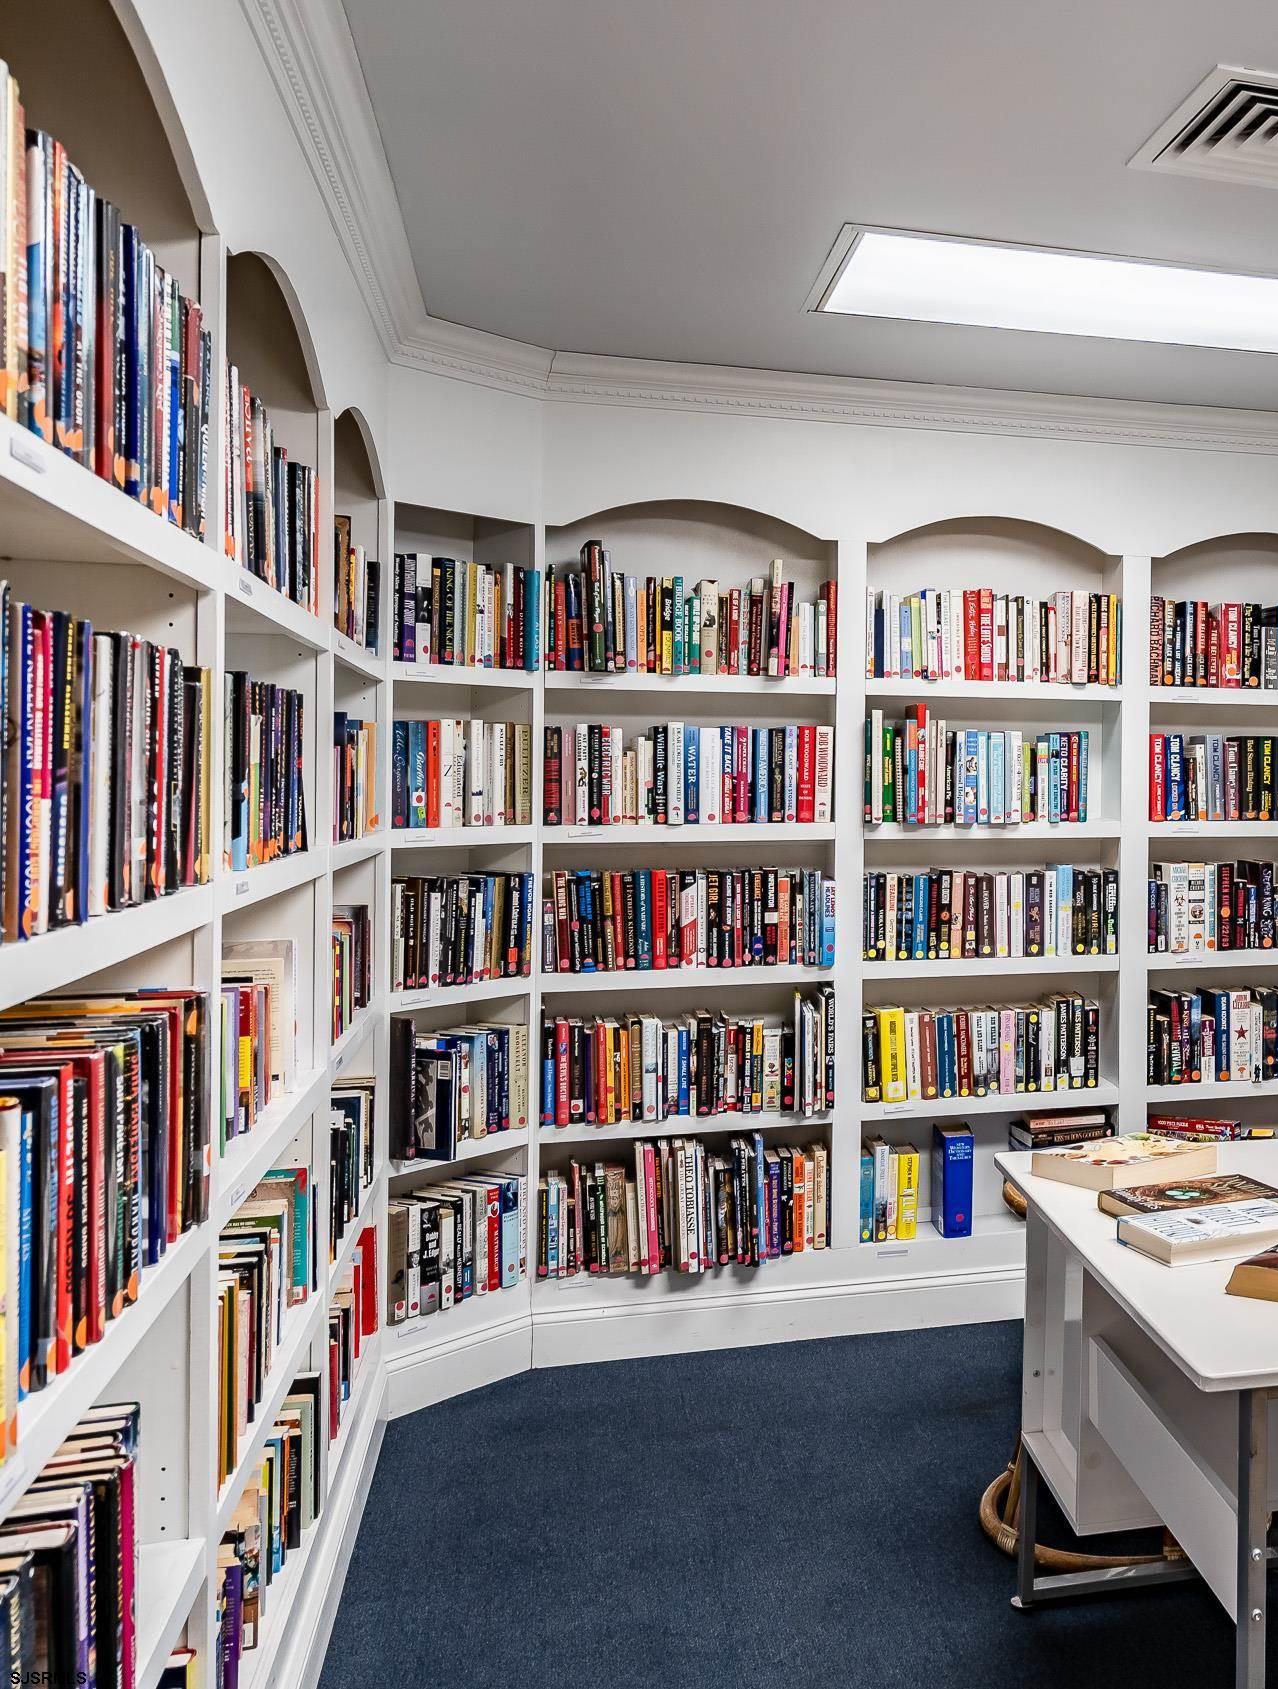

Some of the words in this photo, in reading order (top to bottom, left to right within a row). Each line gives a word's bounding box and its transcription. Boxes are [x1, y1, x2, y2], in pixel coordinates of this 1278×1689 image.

[446, 568, 455, 594] KING
[446, 597, 454, 608] OF
[664, 599, 672, 622] Bridge
[1228, 607, 1237, 621] TOM
[982, 613, 991, 625] THE
[1150, 596, 1159, 637] RICHARD
[982, 626, 991, 641] LATE
[1228, 623, 1237, 648] CLANCY
[981, 643, 991, 663] SHOW
[1150, 640, 1159, 686] BACHMAN
[656, 733, 665, 768] Wildlife
[819, 732, 829, 747] BOB
[1060, 736, 1068, 756] KETO
[1154, 738, 1162, 753] TOM
[688, 746, 696, 783] WATER
[818, 747, 828, 788] WOODWARD
[1060, 758, 1068, 790] CLARITY
[1154, 754, 1162, 783] CLANCY
[657, 770, 665, 794] Wars
[709, 875, 718, 888] JET
[708, 889, 718, 904] GIRL
[1171, 1042, 1181, 1072] REVIVAL
[116, 1076, 124, 1112] SARA
[66, 1079, 74, 1184] MACBETH
[1070, 1133, 1082, 1141] BOYS
[116, 1114, 124, 1183] PARETSKY
[686, 1178, 696, 1235] TOBIASSE
